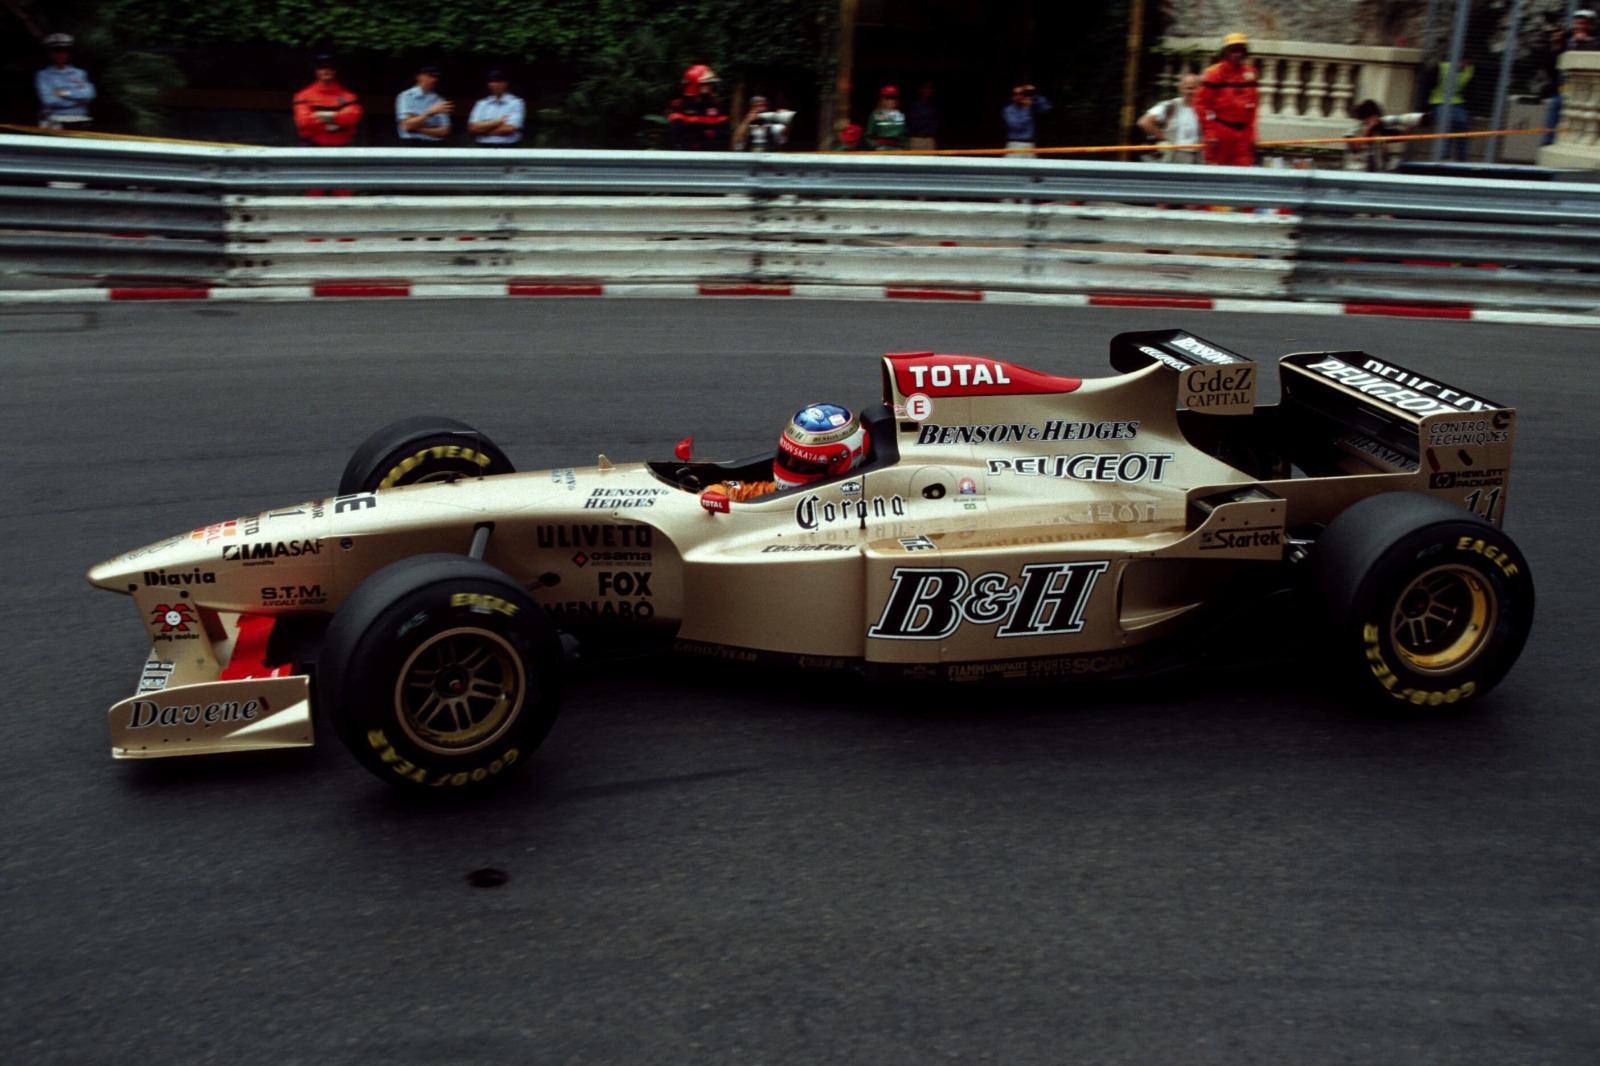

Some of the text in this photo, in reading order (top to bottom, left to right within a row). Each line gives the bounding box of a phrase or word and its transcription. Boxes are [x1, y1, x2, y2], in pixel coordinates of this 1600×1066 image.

[909, 364, 1011, 388] TOTAL
[1187, 367, 1252, 393] GdeZ
[1305, 360, 1461, 417] PEUGEOT
[914, 402, 924, 414] E
[1186, 392, 1250, 408] CAPITAL
[917, 421, 1140, 445] BENSON & HEDGES
[1430, 420, 1491, 434] CONTROL
[1428, 431, 1509, 447] TECHNIQUES
[987, 453, 1174, 483] PEUGEOT
[1457, 469, 1506, 478] HEWLETT
[591, 488, 661, 497] BENSON
[1456, 478, 1503, 487] PACKARD
[584, 498, 657, 509] HEDGES
[702, 499, 723, 509] TOTAL
[796, 493, 906, 530] Corona
[1464, 486, 1503, 524] 11
[537, 524, 652, 547] ULIVETO
[1203, 527, 1282, 549] Startek
[242, 539, 323, 559] IMASAF
[591, 552, 652, 561] osama
[1455, 535, 1521, 579] EAGLE
[144, 567, 216, 586] Diavia
[598, 572, 653, 596] FOX
[261, 585, 327, 599] S.T.M.
[867, 560, 1111, 640] B&H
[153, 633, 172, 642] jolly
[127, 700, 258, 729] Davene
